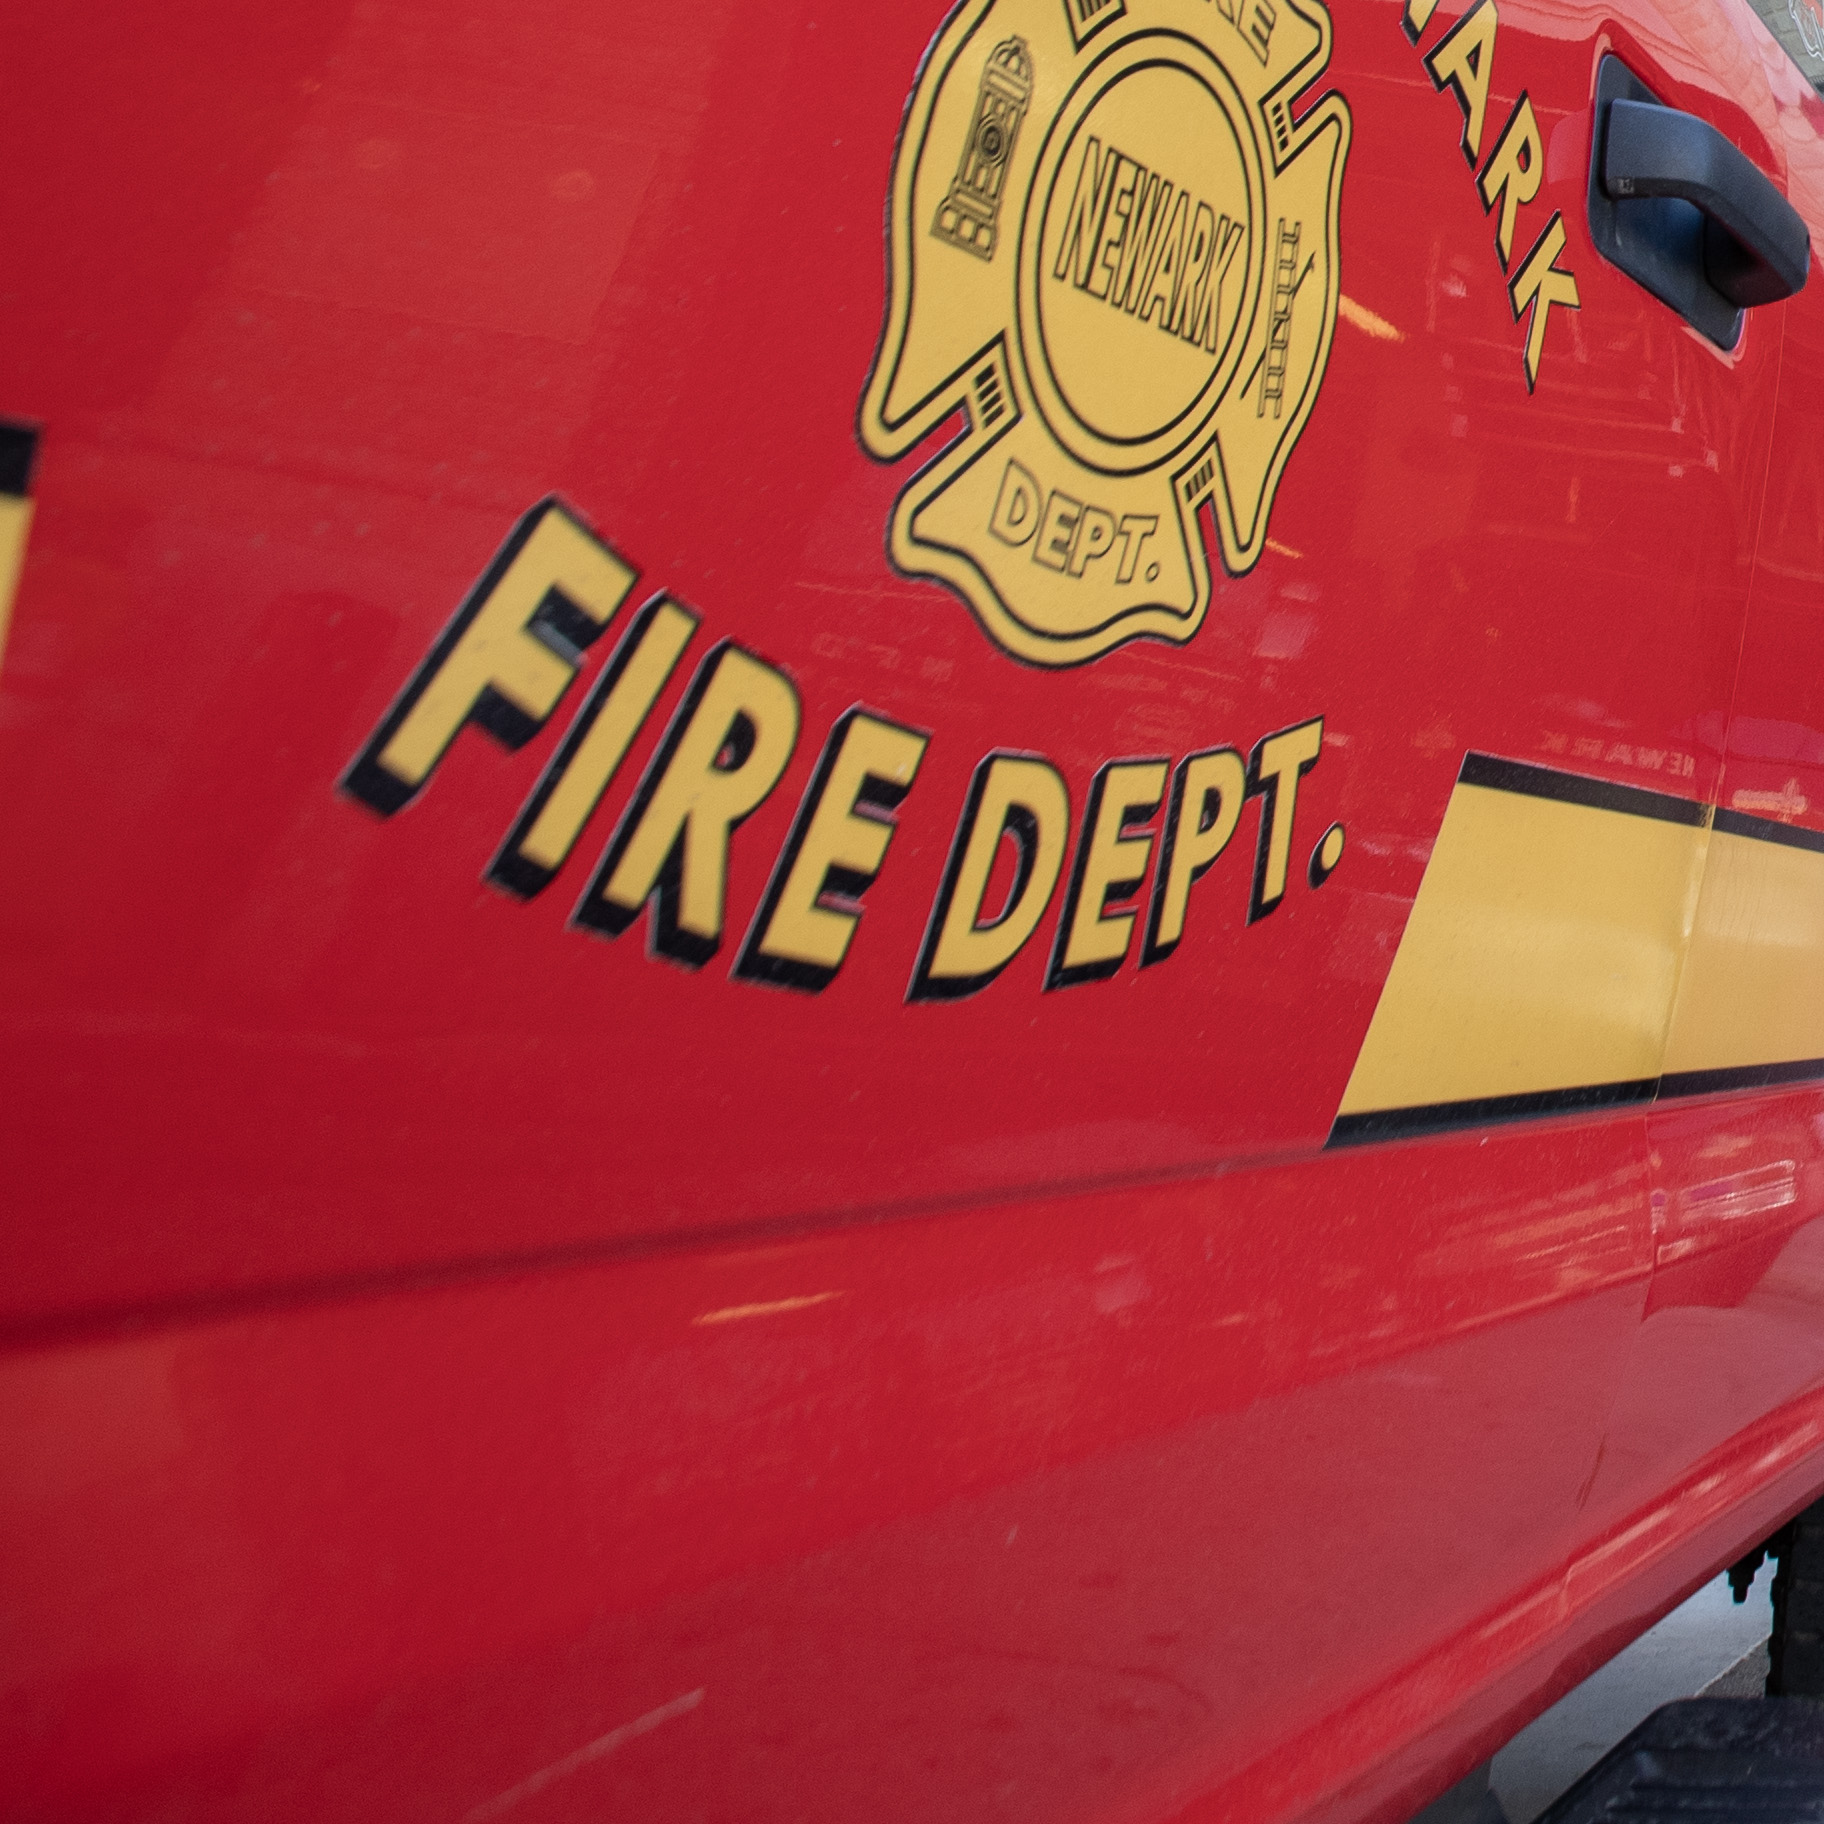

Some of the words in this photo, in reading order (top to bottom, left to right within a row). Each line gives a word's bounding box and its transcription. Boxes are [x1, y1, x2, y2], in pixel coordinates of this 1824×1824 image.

[1056, 138, 1248, 357] NEWARK
[988, 461, 1162, 586] DEPT.
[337, 494, 936, 993] FIRE
[907, 717, 1346, 1002] DEPT.
